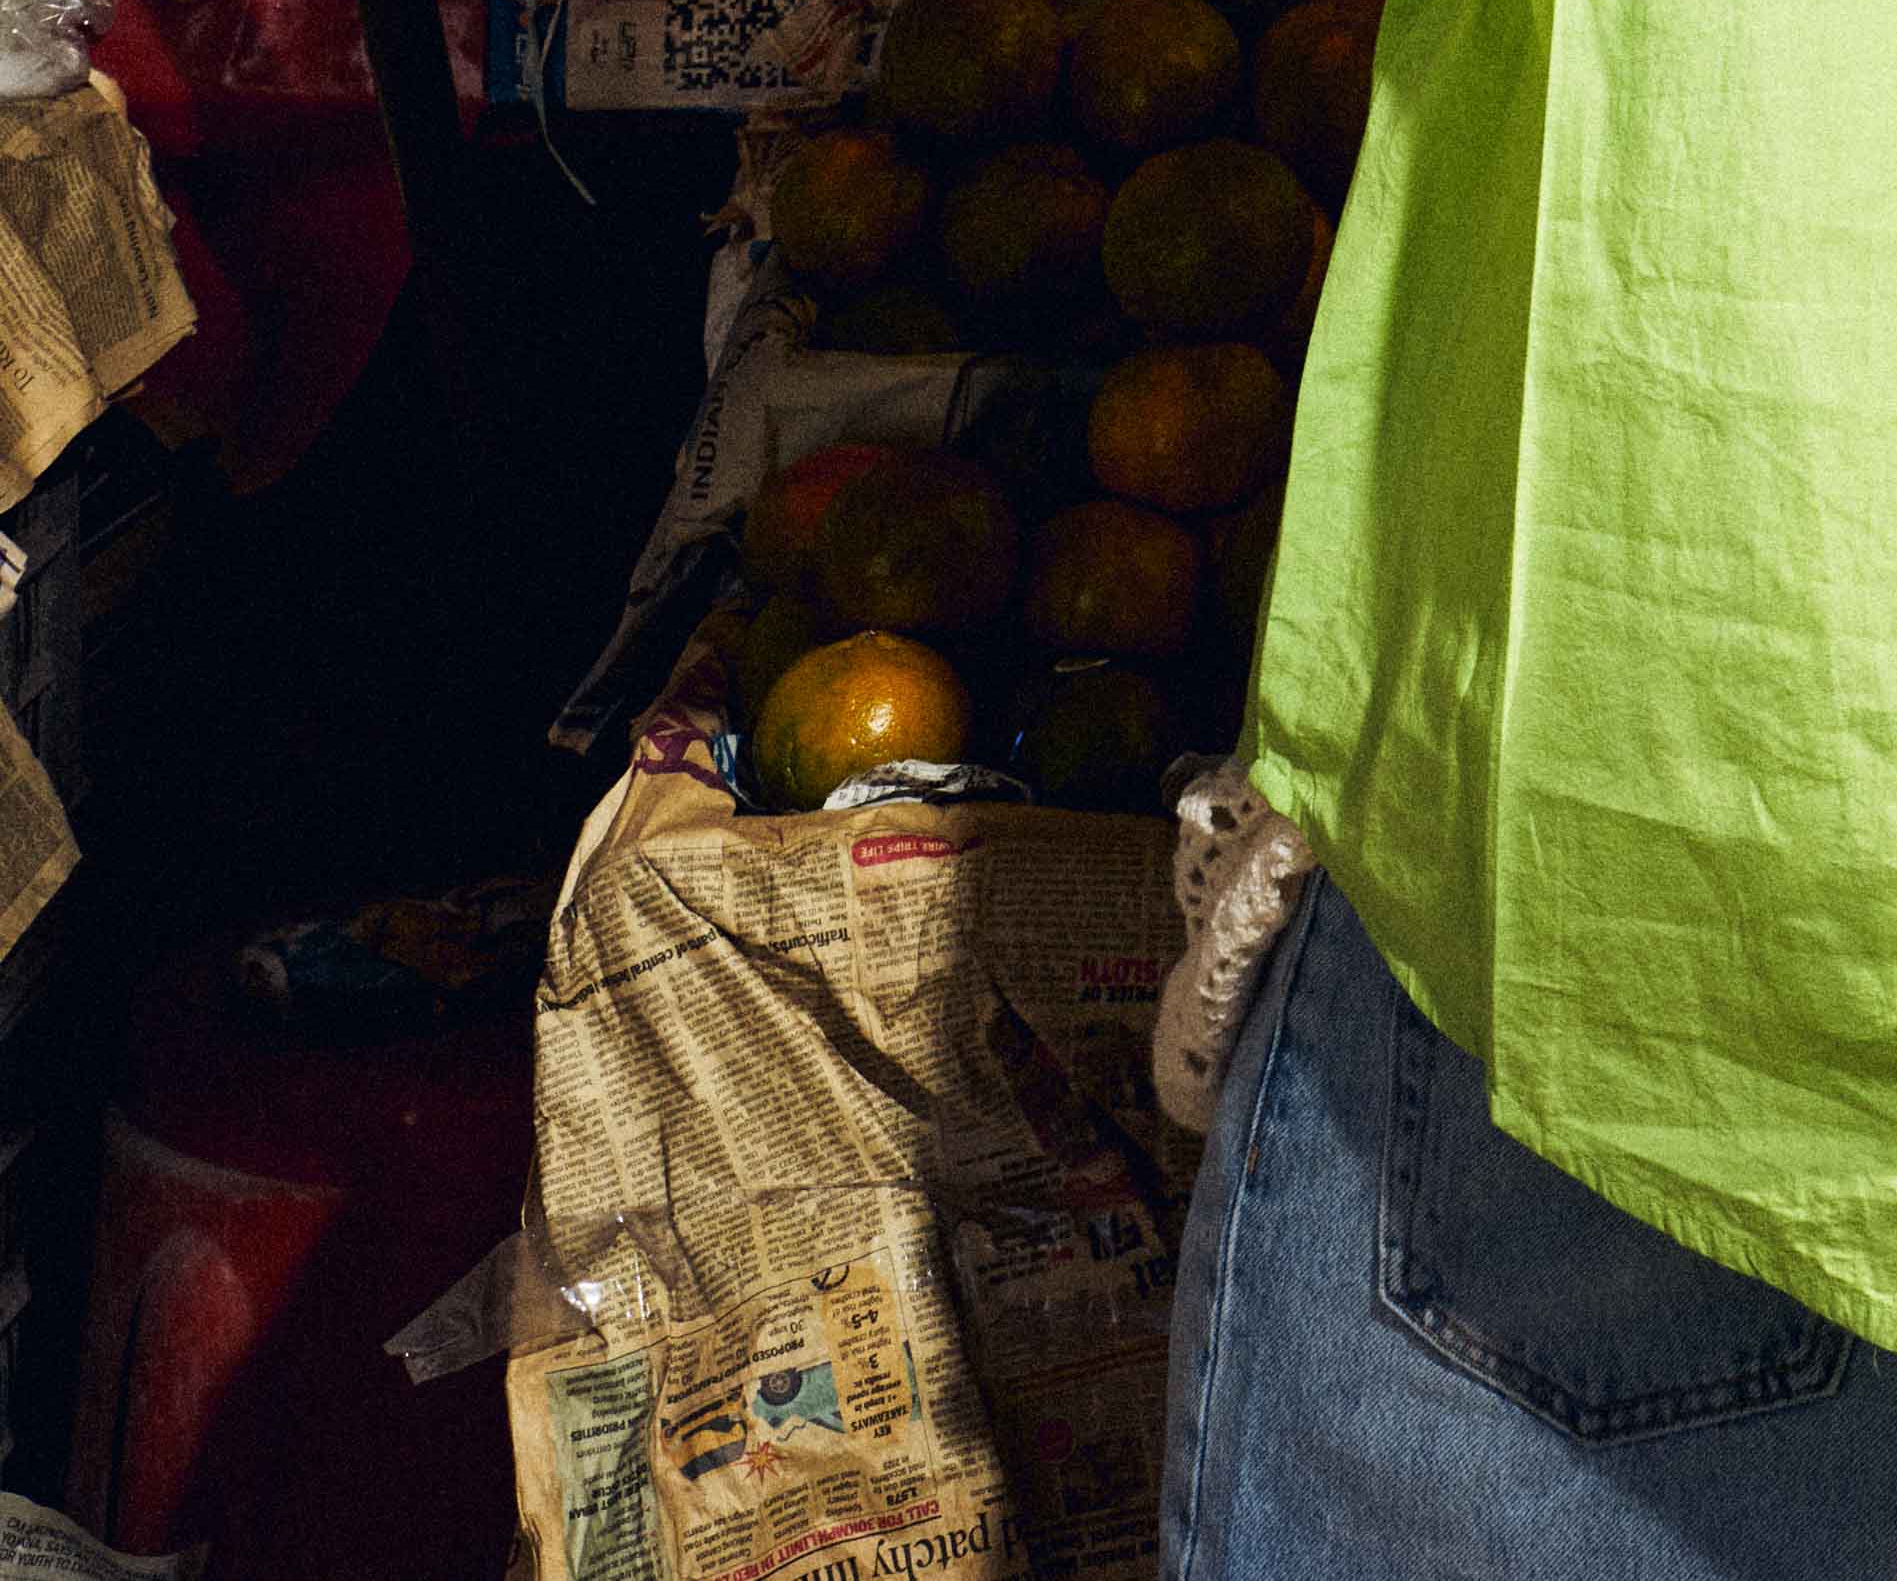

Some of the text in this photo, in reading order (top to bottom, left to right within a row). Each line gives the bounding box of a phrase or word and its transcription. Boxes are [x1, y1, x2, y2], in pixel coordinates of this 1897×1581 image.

[859, 844, 884, 858] LIFE
[887, 841, 918, 853] TRIPS
[808, 927, 851, 949] Traffic
[629, 947, 674, 981] central
[789, 1318, 804, 1335] 30
[751, 1336, 806, 1364] PROPOSED
[850, 1404, 909, 1433] TAKEAWAYS
[569, 1418, 626, 1443] PRIORITIES
[873, 1424, 892, 1439] KEY
[877, 1511, 903, 1529] FOR
[905, 1499, 940, 1520] CALL
[777, 1534, 816, 1564] LIMIT
[872, 1513, 992, 1581] patchy
[760, 1553, 774, 1573] IN
